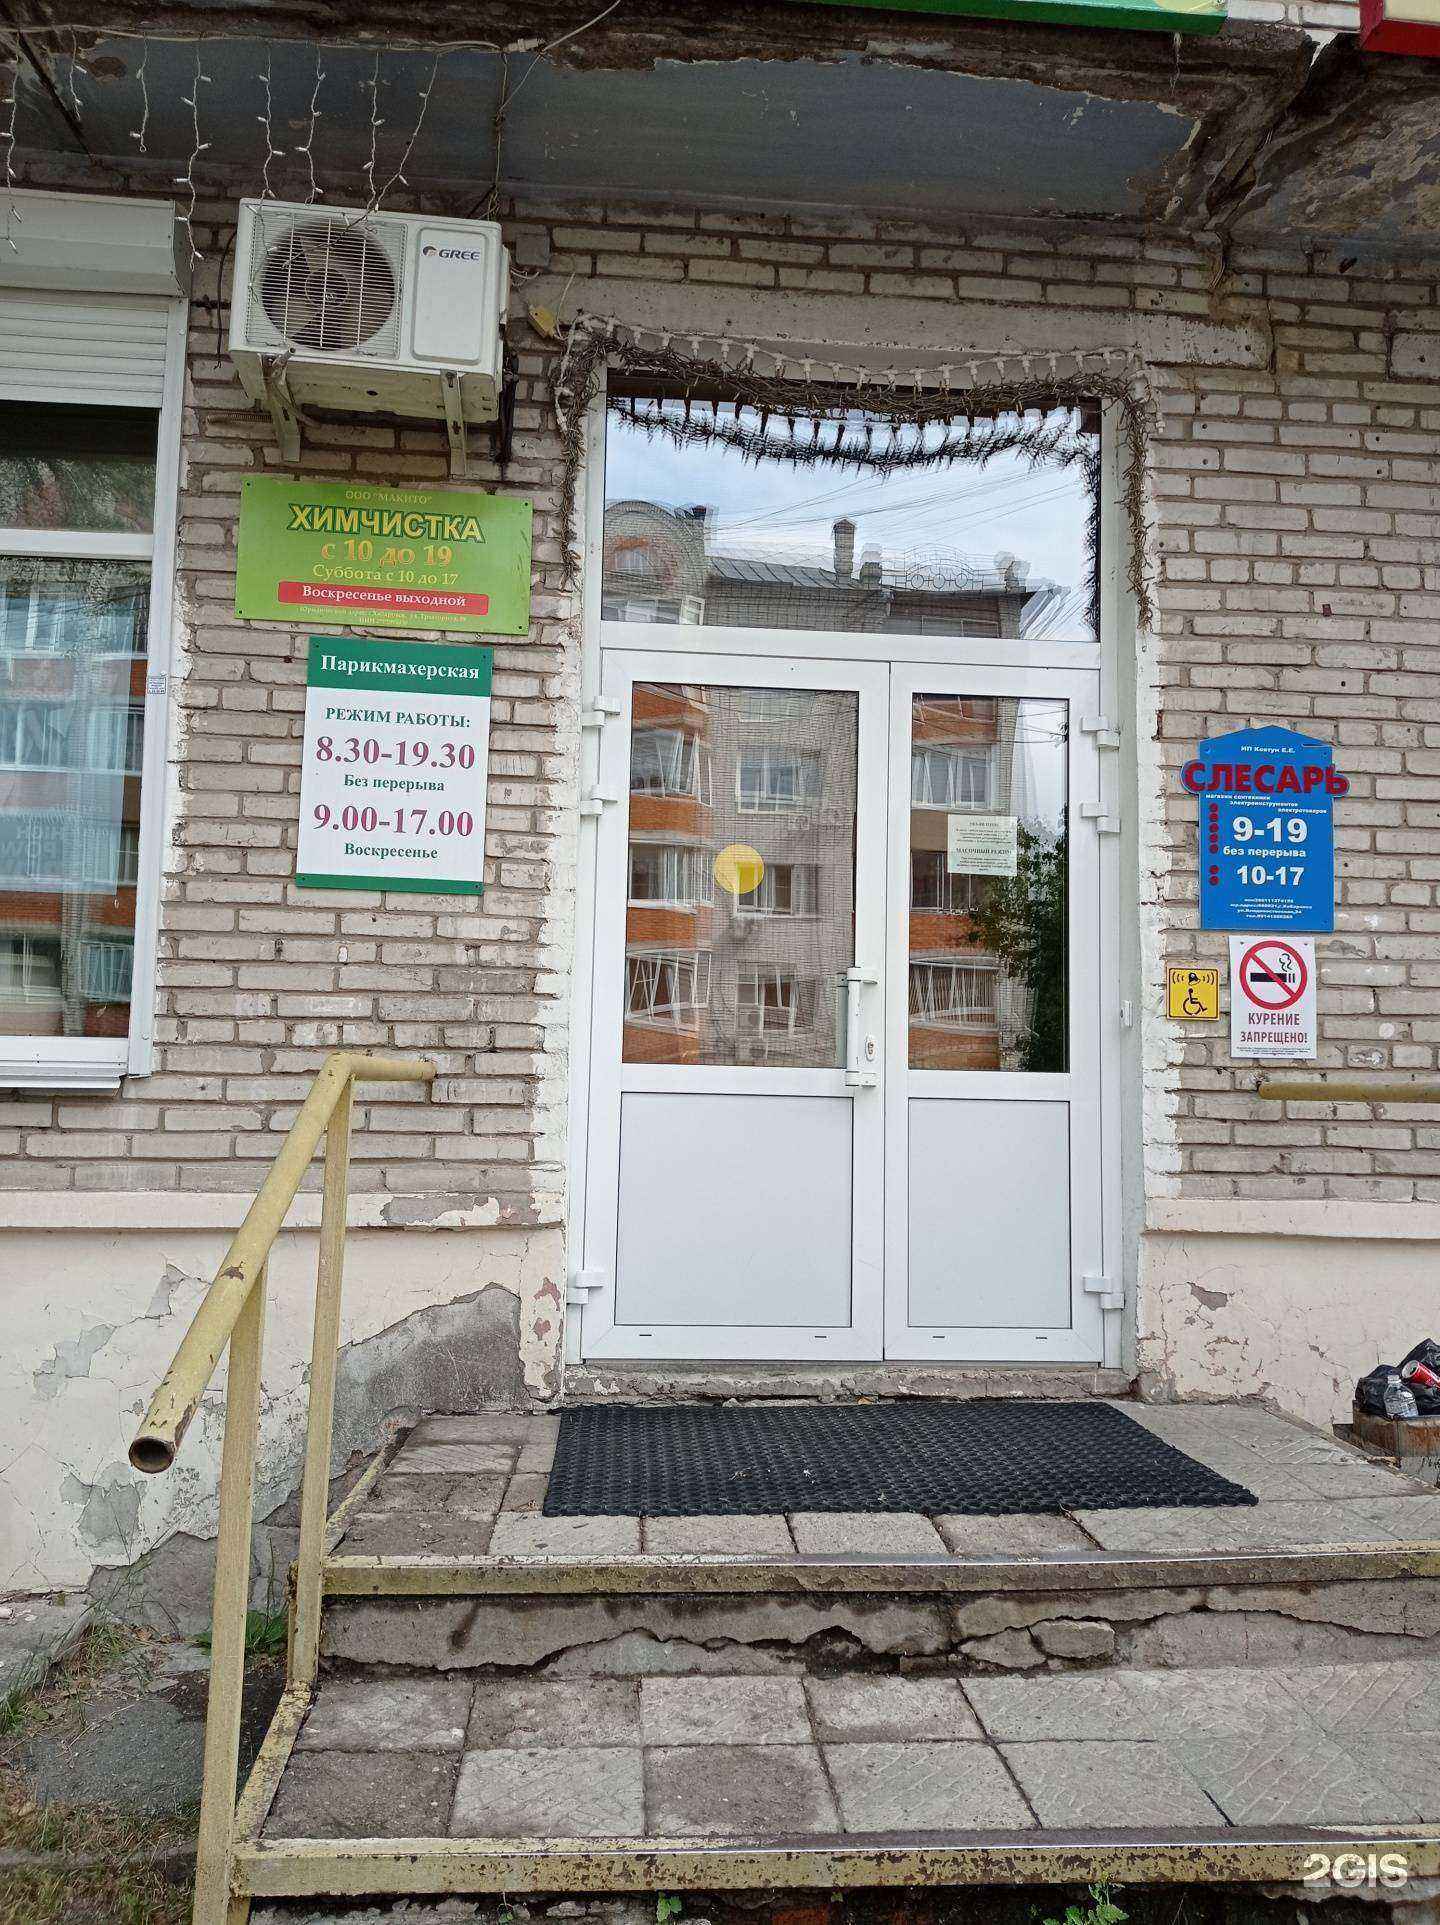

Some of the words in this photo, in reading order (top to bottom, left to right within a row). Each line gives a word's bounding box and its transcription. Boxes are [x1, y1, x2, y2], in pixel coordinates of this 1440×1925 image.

[439, 249, 480, 260] GREE
[345, 490, 371, 501] ООО
[288, 503, 486, 542] ХИМЧИСТКА
[321, 543, 337, 560] с
[344, 539, 373, 563] 10
[379, 548, 414, 568] до
[423, 545, 453, 567] 19
[313, 564, 382, 583] Суббота
[385, 573, 395, 582] с
[399, 570, 416, 583] 10
[418, 574, 438, 585] до
[441, 573, 459, 585] 17
[302, 585, 392, 603] Воскресенье
[395, 594, 466, 607] выходной
[320, 655, 480, 679] Парикмахерская
[325, 707, 391, 723] РЕЖИМ
[395, 711, 471, 728] РАБОТЫ:
[316, 736, 475, 769] 8.30-19.30
[344, 775, 368, 787] Без
[372, 779, 445, 793] перерыва
[1184, 762, 1349, 795] СЛЕСАРЬ
[312, 804, 474, 836] 9.00-17.00
[1232, 816, 1308, 843] 9-19
[344, 842, 438, 859] Воскресенье
[1223, 846, 1244, 856] без
[1248, 848, 1306, 859] перерыва
[1236, 865, 1305, 886] 10-17
[1248, 1012, 1300, 1026] КУРЕНИЕ
[1240, 1031, 1308, 1045] ЗАПРЕЩЕНО!
